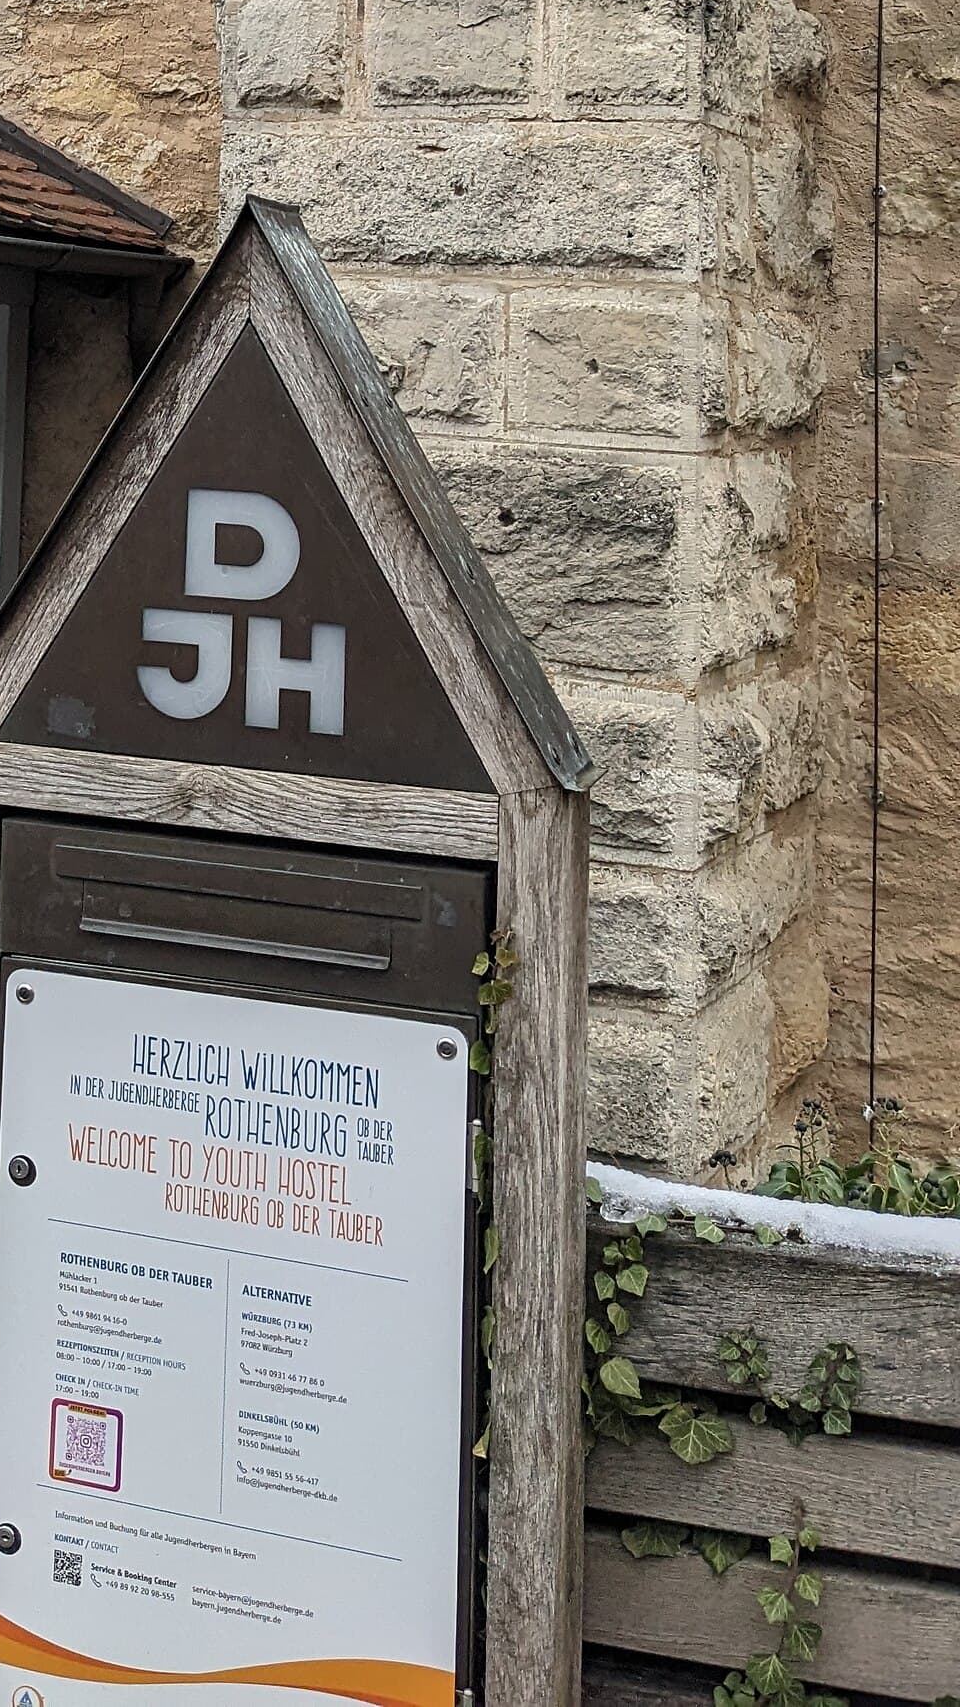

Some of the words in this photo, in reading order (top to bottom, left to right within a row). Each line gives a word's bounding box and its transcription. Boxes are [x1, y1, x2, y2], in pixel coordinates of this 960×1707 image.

[184, 488, 300, 601] D
[70, 1074, 80, 1095] IN
[85, 1076, 105, 1100] DER
[108, 1080, 200, 1113] JUGENDHERBERGE
[205, 1095, 347, 1158] ROTHENBURG
[357, 1117, 370, 1138] OB
[374, 1119, 393, 1142] DER
[68, 1123, 158, 1174] WELCOME
[168, 1139, 191, 1180] TO
[202, 1145, 266, 1192] YOUTH
[279, 1156, 352, 1205] HOSTEL
[357, 1140, 394, 1165] TAUBER
[165, 1182, 259, 1226] ROTHENBURG
[266, 1199, 284, 1229] OB
[292, 1203, 320, 1236] DER
[328, 1208, 383, 1247] TAUBER
[60, 1252, 128, 1274] ROTHENBURG
[131, 1264, 145, 1277] OB
[149, 1267, 169, 1283] DER
[172, 1271, 213, 1290] TAUBER
[60, 1271, 91, 1283] Mühlacker
[59, 1283, 78, 1293] 91541
[80, 1286, 118, 1301] Rothenburg
[129, 1295, 140, 1304] der
[142, 1297, 163, 1308] Tauber
[242, 1284, 312, 1307] ALTERNATIVE
[57, 1319, 162, 1344] rothenburg@jugendherberge.de
[241, 1311, 282, 1326] WÜRZBURG
[283, 1319, 296, 1330] (73
[298, 1322, 313, 1333] KM)
[241, 1327, 302, 1345] Fred-Joseph-Platz
[56, 1339, 119, 1358] REZEPTIONSZEITEN
[126, 1352, 161, 1366] RECEPTION
[163, 1359, 186, 1371] HOURS
[241, 1340, 261, 1350] 97082
[262, 1344, 293, 1358] Würzburg
[83, 1357, 100, 1367] 10:00
[108, 1362, 126, 1371] 17:00
[134, 1366, 152, 1376] 19:00
[254, 1368, 267, 1376] +49
[269, 1370, 286, 1380] 0931
[55, 1373, 76, 1384] CHECK
[78, 1377, 86, 1385] IN
[92, 1380, 123, 1394] CHECK-IN
[124, 1386, 139, 1396] TIME
[55, 1384, 73, 1394] 17:00
[239, 1378, 347, 1404] wuerzburg@jugendherberge.de
[238, 1410, 288, 1427] DINKELSBÜHL
[290, 1420, 303, 1430] (50
[305, 1423, 320, 1434] KM)
[238, 1426, 282, 1441] Koppengasse
[284, 1435, 293, 1443] 10
[237, 1438, 259, 1449] 91550
[260, 1442, 300, 1457] Dinkelsbühl
[252, 1467, 265, 1475] +49
[266, 1468, 282, 1479] 9851
[236, 1475, 338, 1502] info@jugendherberge-dkb.de
[54, 1533, 84, 1546] KONTAKT
[91, 1541, 119, 1554] CONTACT
[55, 1510, 94, 1525] Information
[109, 1521, 138, 1537] Buchung
[139, 1528, 149, 1537] für
[151, 1532, 163, 1541] alle
[164, 1534, 222, 1553] Jugendherbergen
[233, 1548, 256, 1560] Bayern
[91, 1563, 116, 1575] Service
[124, 1570, 152, 1585] Booking
[154, 1576, 177, 1588] Center
[105, 1581, 118, 1589] +49
[120, 1583, 129, 1591] 89
[130, 1585, 139, 1593] 92
[140, 1587, 149, 1595] 20
[151, 1590, 175, 1601] 98-555
[192, 1585, 314, 1618] service-bayern@jugendherberge.de
[192, 1598, 282, 1624] bayern.jugendherberge.de
